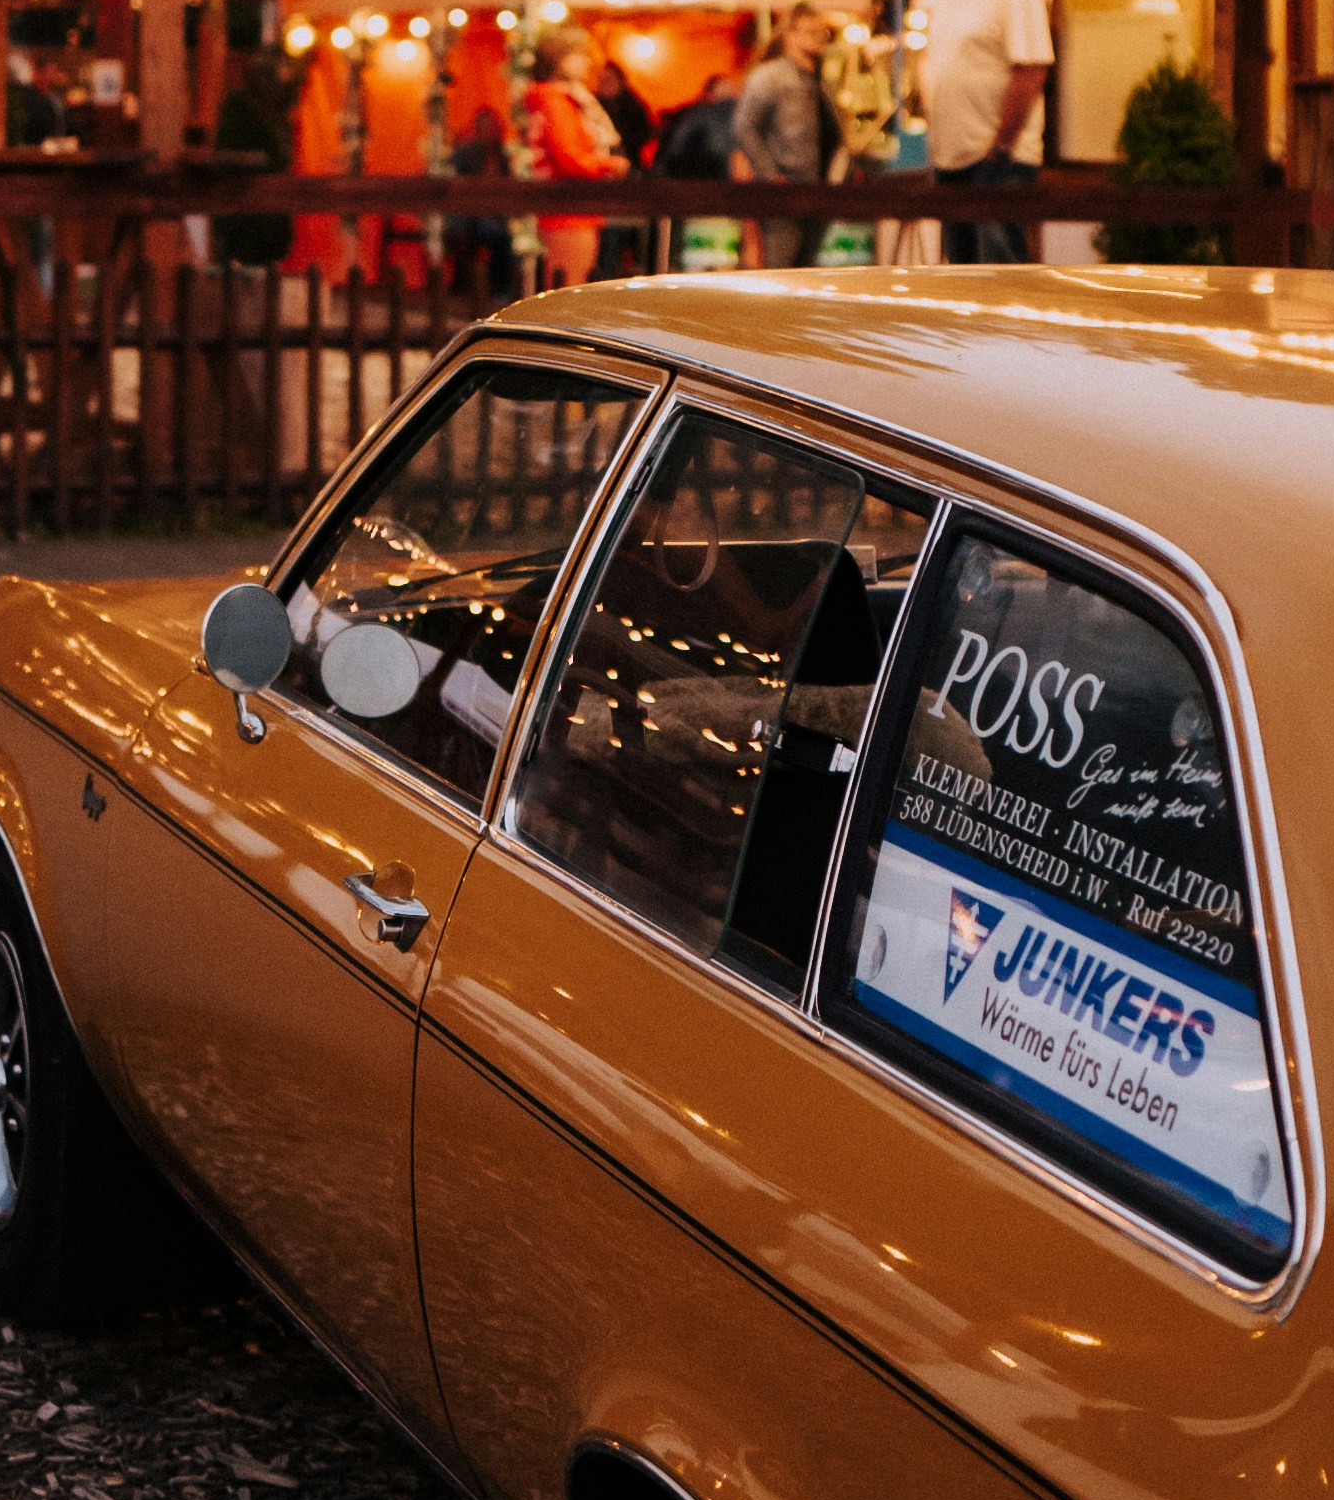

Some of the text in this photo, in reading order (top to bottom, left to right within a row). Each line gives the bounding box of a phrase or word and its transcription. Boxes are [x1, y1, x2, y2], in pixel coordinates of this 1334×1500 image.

[928, 628, 1106, 768] POSS
[912, 753, 1244, 927] KLEMPNEREI INSTALLATION
[1067, 743, 1124, 809] Gas
[1129, 761, 1158, 783] im
[899, 794, 934, 825] 588
[934, 803, 1069, 888] LÜDENSCHEID
[1126, 893, 1170, 933] Ruf
[1167, 918, 1234, 966] 22220
[980, 986, 1179, 1132] Wärme fürs Leben
[993, 924, 1216, 1078] JUNKERS
